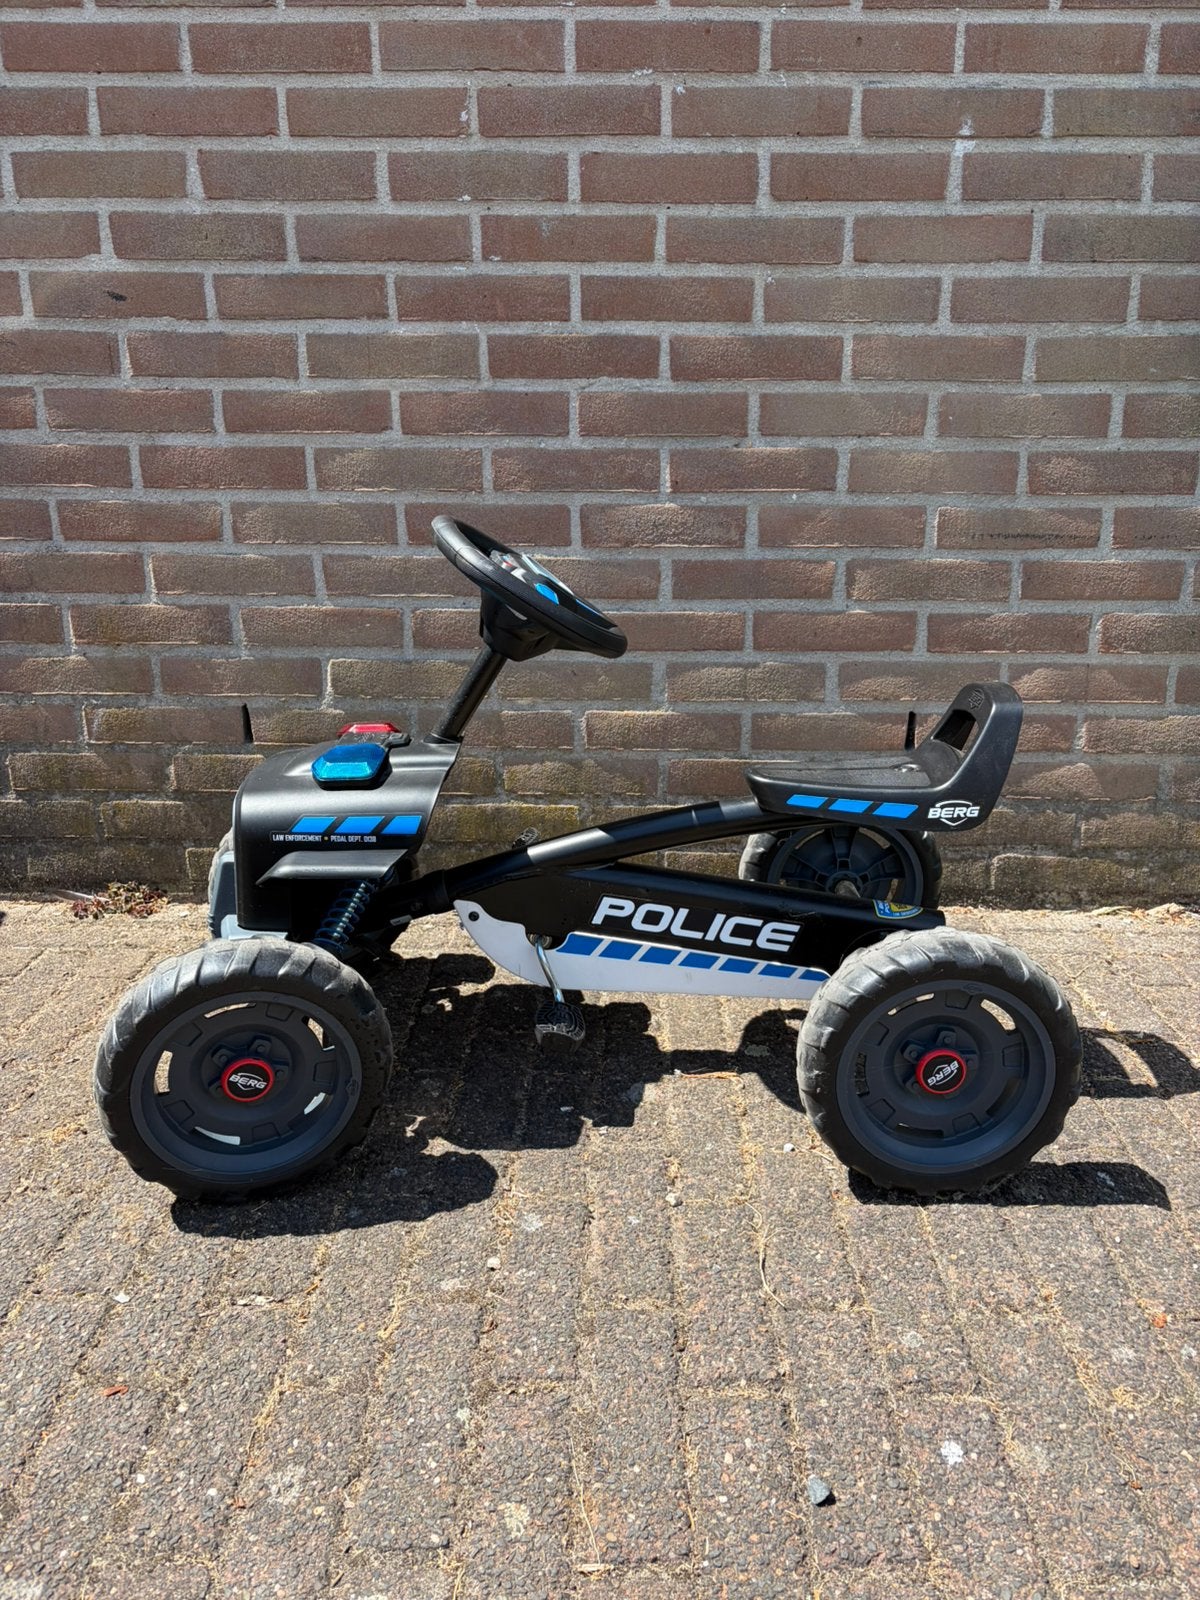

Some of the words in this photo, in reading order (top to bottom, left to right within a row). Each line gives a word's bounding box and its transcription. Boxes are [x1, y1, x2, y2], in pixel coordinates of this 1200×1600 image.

[927, 806, 980, 819] BERG
[272, 834, 284, 842] LAW
[285, 834, 322, 843] ENFORCEMENT
[330, 835, 347, 843] PEDAL
[348, 835, 363, 843] DEPT.
[591, 896, 801, 952] POLICE
[927, 1060, 959, 1087] BERG
[229, 1074, 268, 1089] BERG
